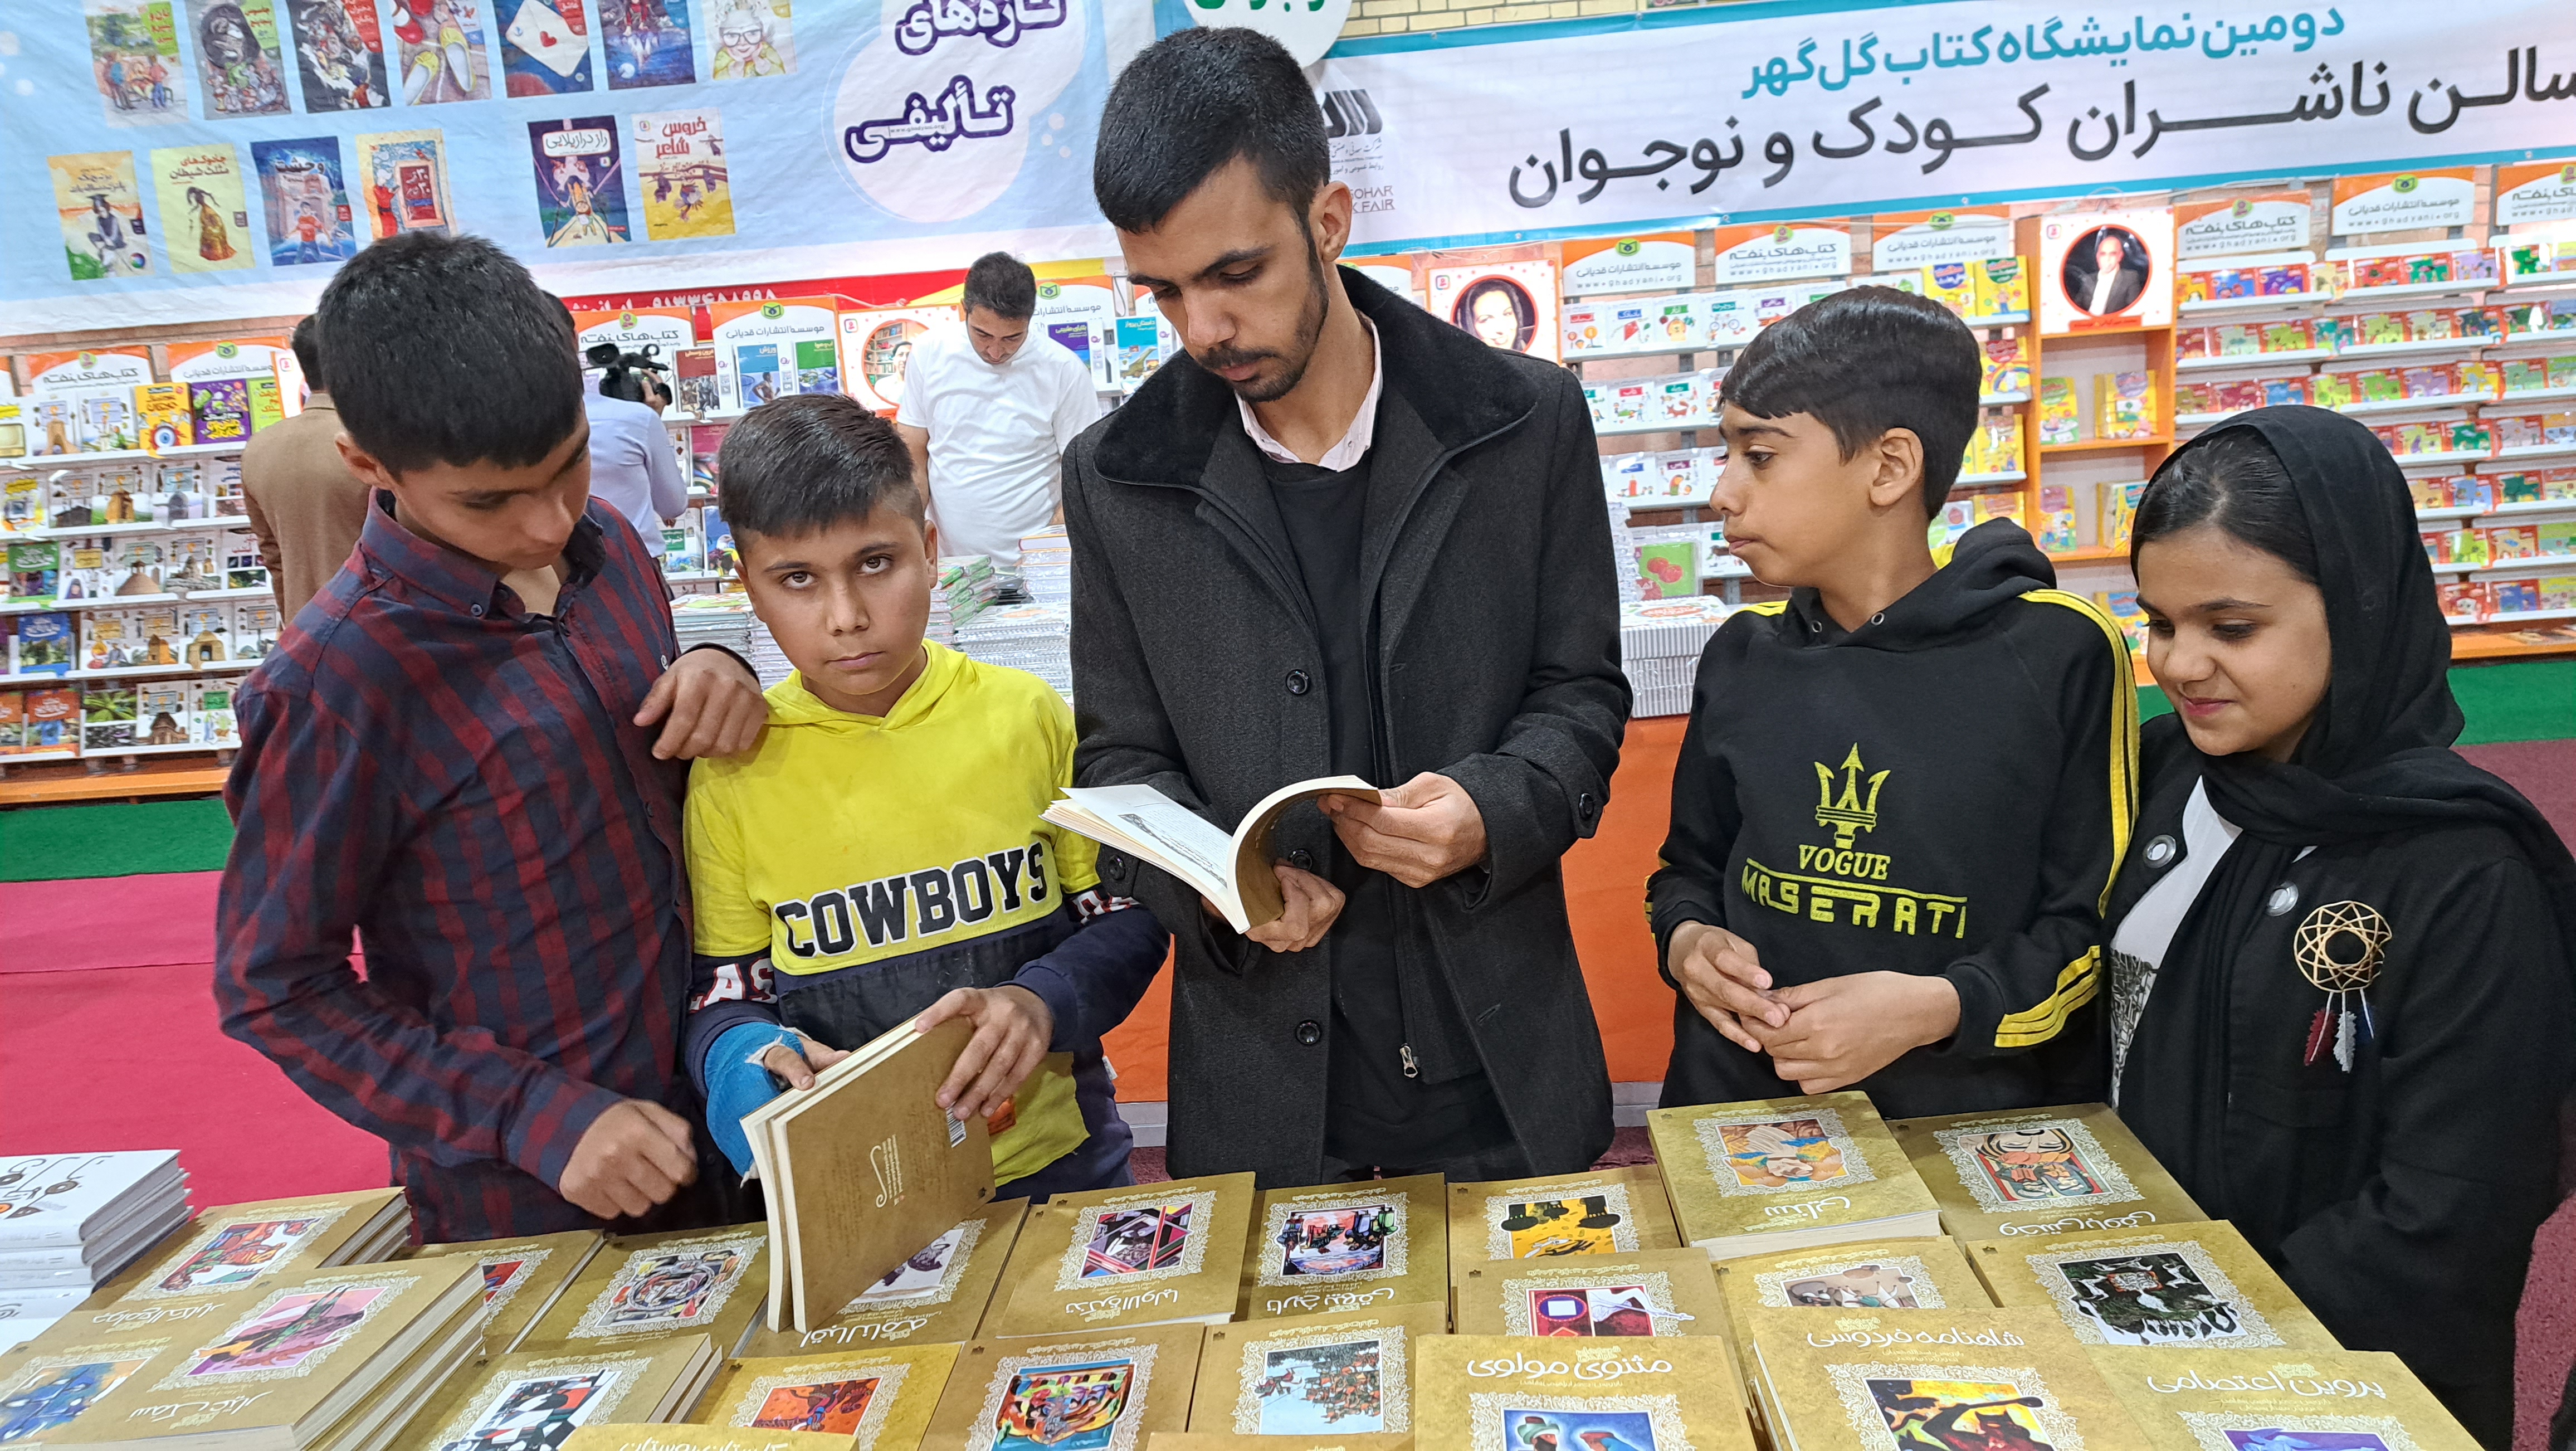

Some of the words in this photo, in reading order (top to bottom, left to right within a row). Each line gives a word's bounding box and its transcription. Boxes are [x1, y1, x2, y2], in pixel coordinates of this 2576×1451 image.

[1998, 16, 2196, 67] نمایشگاه
[2202, 6, 2346, 60] دومین
[1884, 25, 1993, 85] کتاب
[2408, 47, 2576, 134] سالن
[1813, 82, 2051, 175] کودک
[2067, 59, 2390, 162] ناشران
[1509, 115, 1745, 208] نوجوان
[1762, 130, 1795, 189] و
[726, 329, 755, 339] قدیانی
[1799, 844, 1891, 880] VOGUE
[775, 842, 1048, 958] COWBOYS
[1998, 1218, 2082, 1237] وحشی
[2084, 1211, 2156, 1233] بافقی
[1266, 1292, 1320, 1316] تاریخ
[1324, 1287, 1395, 1311] بیهقی
[1806, 1328, 1914, 1348] فردوسی
[1915, 1327, 2026, 1347] شاهنامه
[1467, 1352, 1570, 1379] مولوی
[1574, 1354, 1673, 1380] مثنوی
[2146, 1369, 2286, 1393] اعتصامی
[2289, 1379, 2387, 1399] پروین
